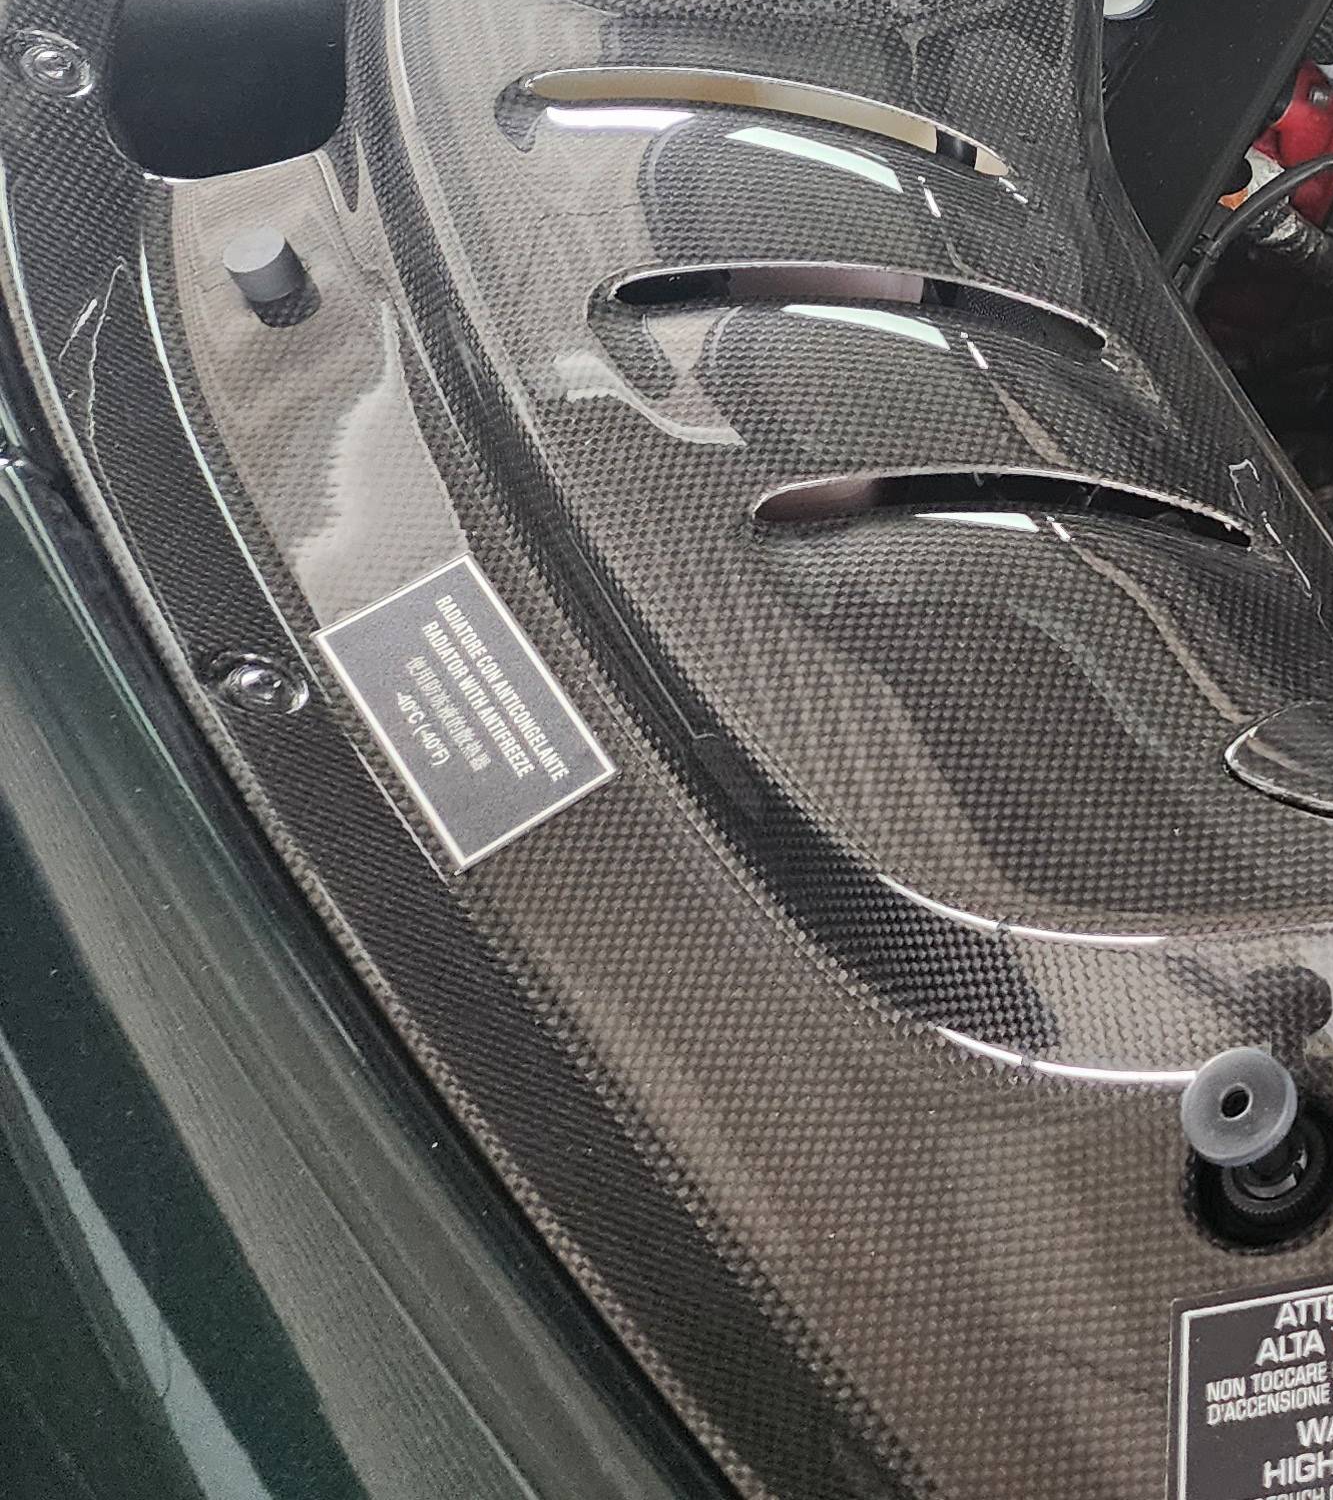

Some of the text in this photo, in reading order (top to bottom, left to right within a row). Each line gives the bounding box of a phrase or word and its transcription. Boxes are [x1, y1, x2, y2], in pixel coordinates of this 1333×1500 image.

[421, 620, 535, 780] RADIATOR WITH ANTIFREEZE
[436, 595, 570, 783] RADIATORE CON ANTICONGELANTE
[1255, 1329, 1325, 1367] ALTA
[1206, 1377, 1246, 1401] NON
[1250, 1361, 1327, 1392] TOCCARE
[1206, 1383, 1331, 1426] D'ACCENSIONE
